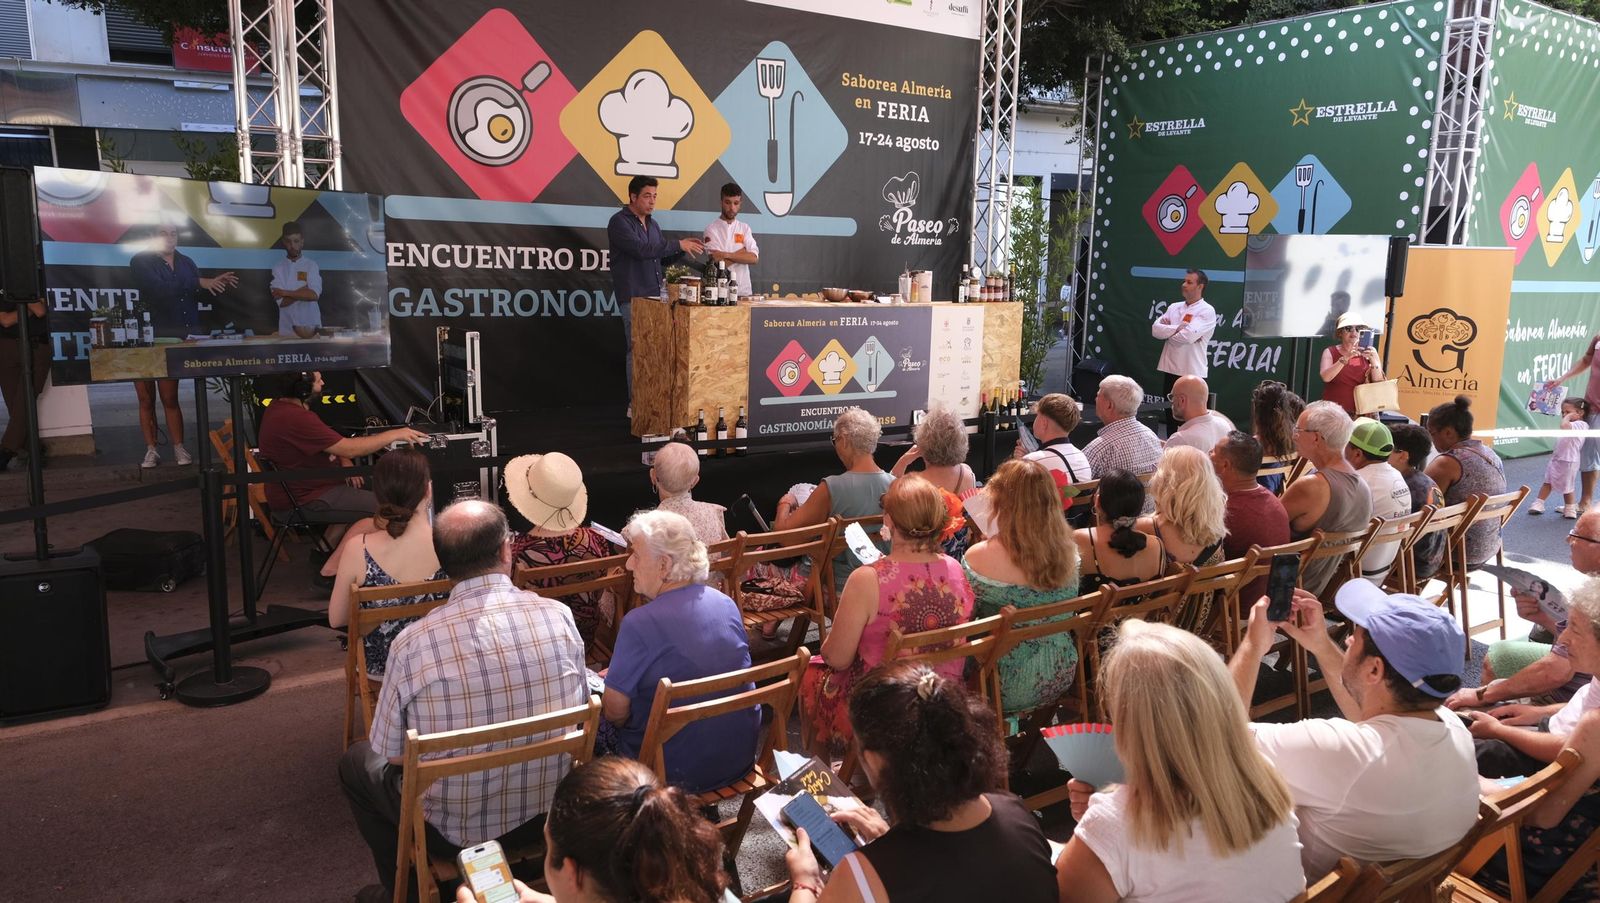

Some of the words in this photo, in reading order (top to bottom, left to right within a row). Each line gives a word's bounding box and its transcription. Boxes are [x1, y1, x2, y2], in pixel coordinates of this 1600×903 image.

[842, 72, 897, 92] Saborea
[901, 80, 952, 99] Almería
[855, 97, 872, 109] en
[877, 101, 930, 123] FERIA
[1316, 100, 1398, 118] ESTRELLA
[1344, 113, 1378, 121] LEVANTE
[1517, 103, 1556, 123] ESTRELLA
[1145, 117, 1206, 132] ESTRELLA
[859, 131, 893, 148] 17-24
[895, 136, 940, 152] agosto
[892, 207, 944, 234] Paseo
[891, 233, 902, 244] de
[903, 232, 943, 246] Almería
[386, 242, 574, 271] ENCUENTRO
[388, 287, 623, 317] GASTRONOM
[764, 319, 795, 328] Saborea
[840, 317, 868, 326] FERIA
[1547, 318, 1587, 340] Almería
[184, 359, 222, 369] Saborea
[278, 354, 312, 364] FERIA
[1396, 364, 1478, 391] Almería
[1517, 368, 1531, 385] en
[800, 405, 849, 417] ENCUENTRO
[759, 417, 834, 435] GASTRONOMÍA
